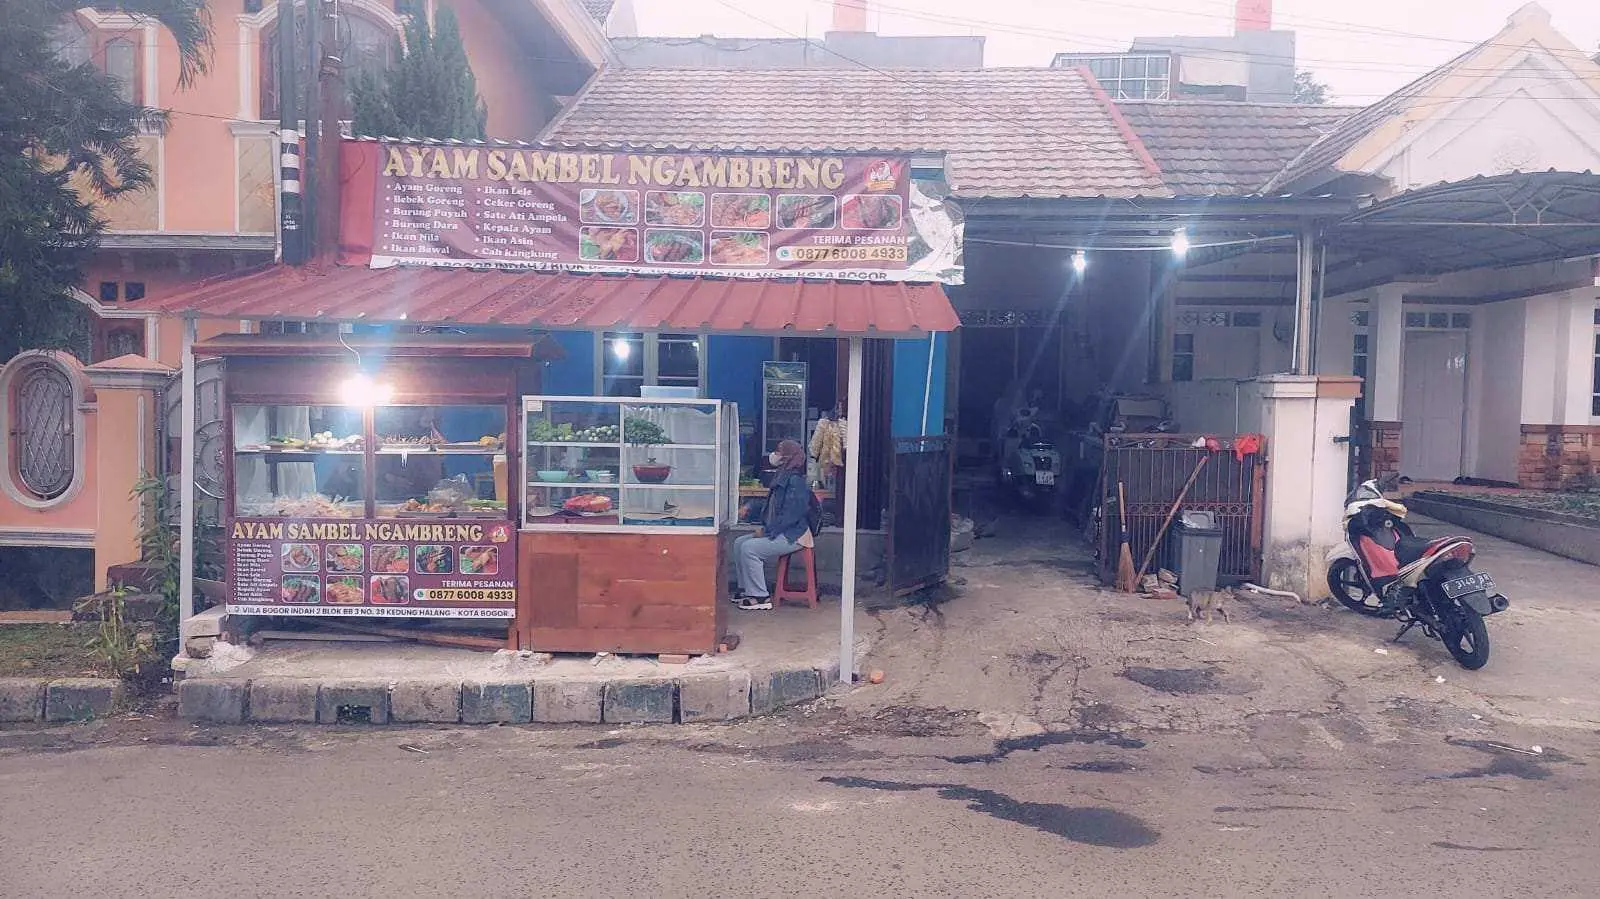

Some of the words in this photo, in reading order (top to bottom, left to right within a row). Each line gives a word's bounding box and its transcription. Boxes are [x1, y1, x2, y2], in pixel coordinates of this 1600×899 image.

[382, 147, 480, 179] AYAM
[486, 150, 621, 184] SAMBEL
[627, 154, 846, 190] NGAMBRENG
[813, 235, 852, 245] TERIMA
[854, 235, 905, 246] PESANAN
[796, 248, 828, 260] 0877
[833, 247, 867, 260] 6008
[871, 247, 905, 260] 4933
[231, 522, 284, 539] AYAM
[287, 523, 362, 540] SAMBEL
[365, 524, 484, 541] NGAMBRENG
[1444, 583, 1450, 592] F
[430, 590, 454, 599] 0877
[457, 590, 484, 600] 6008
[487, 590, 513, 600] 4933
